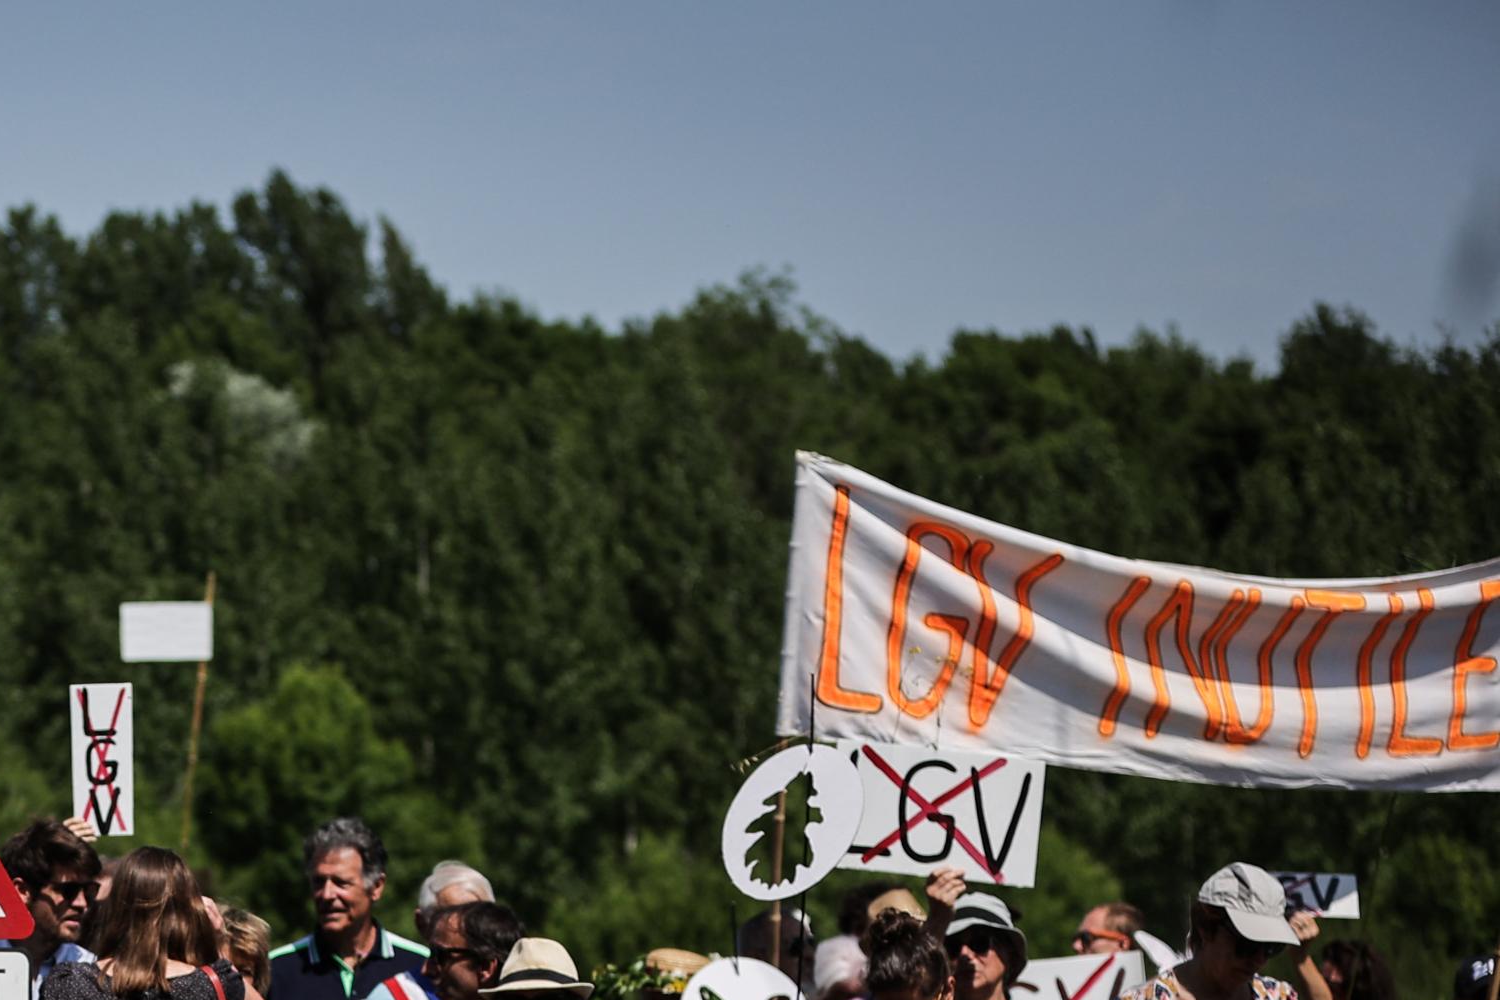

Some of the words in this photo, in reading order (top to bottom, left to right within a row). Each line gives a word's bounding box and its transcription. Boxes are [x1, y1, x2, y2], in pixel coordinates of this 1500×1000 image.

[815, 483, 1064, 727] LGV
[1100, 575, 1500, 760] INUTILE
[82, 686, 121, 836] LGV
